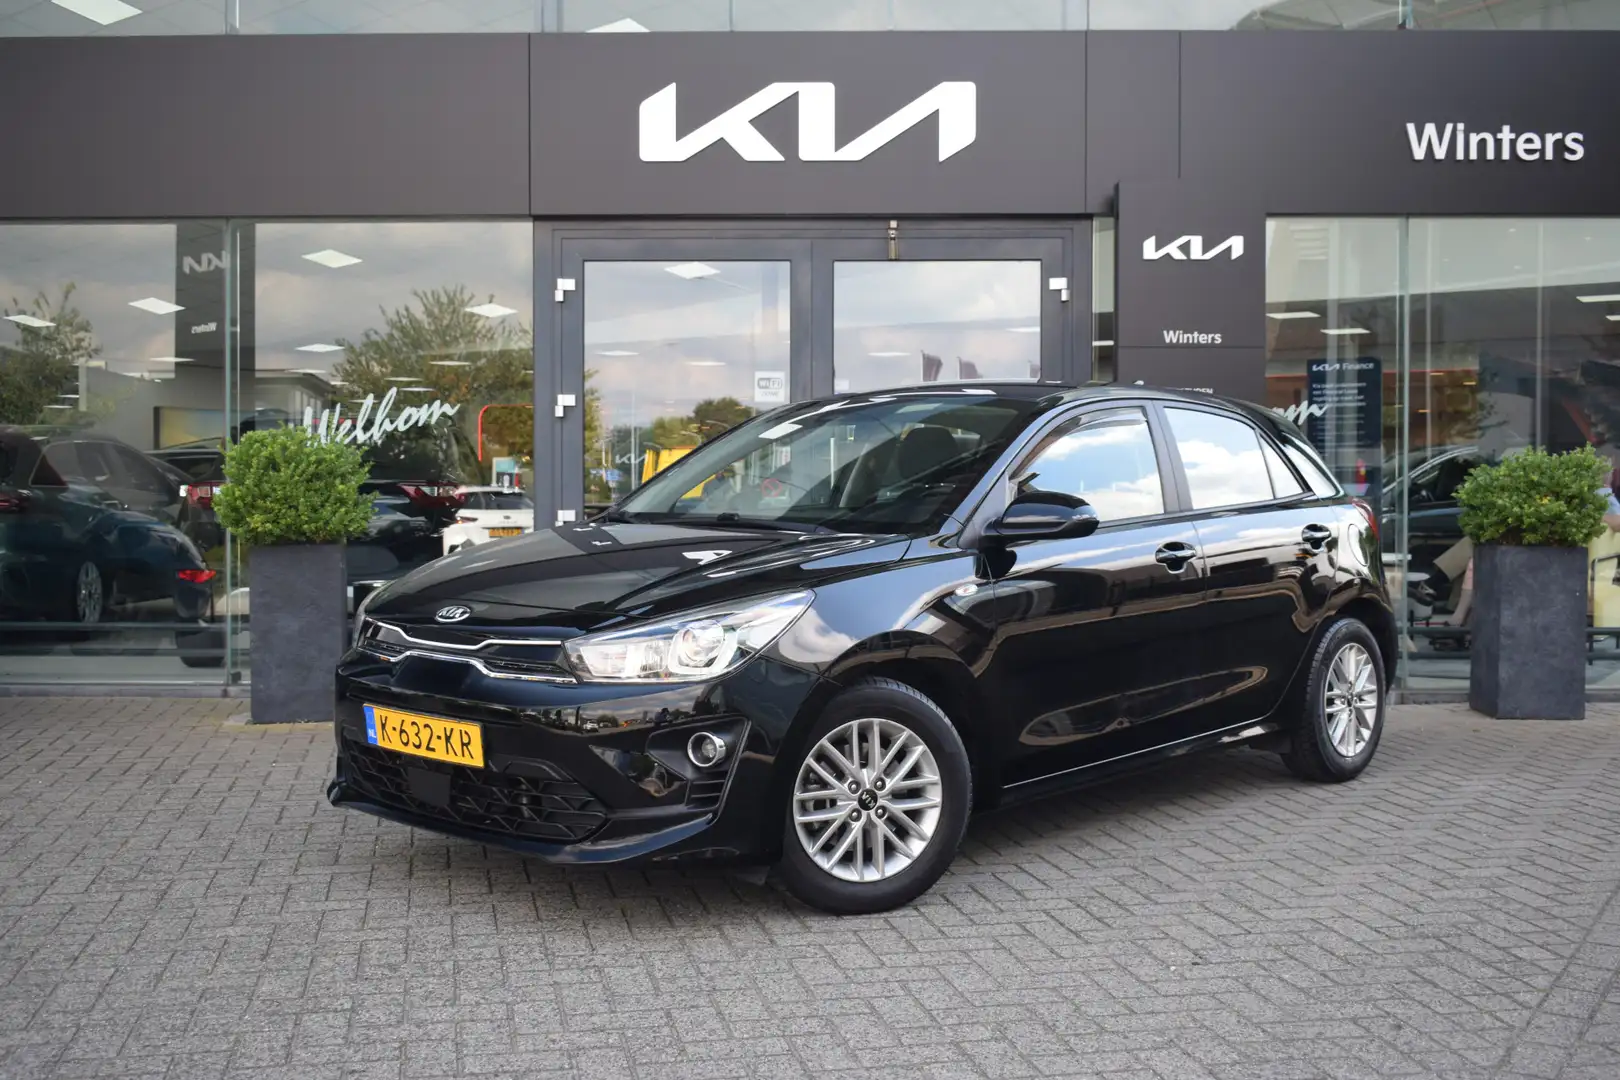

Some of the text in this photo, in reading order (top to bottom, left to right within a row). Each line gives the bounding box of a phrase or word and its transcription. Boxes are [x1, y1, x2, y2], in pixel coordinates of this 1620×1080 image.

[639, 81, 977, 162] KIA
[1406, 122, 1585, 162] Winters
[1142, 235, 1244, 261] KIA
[1163, 330, 1222, 344] Winters
[1342, 362, 1375, 370] Finance
[437, 606, 467, 619] KIA
[368, 728, 377, 738] NL
[379, 714, 475, 760] K-632-KR
